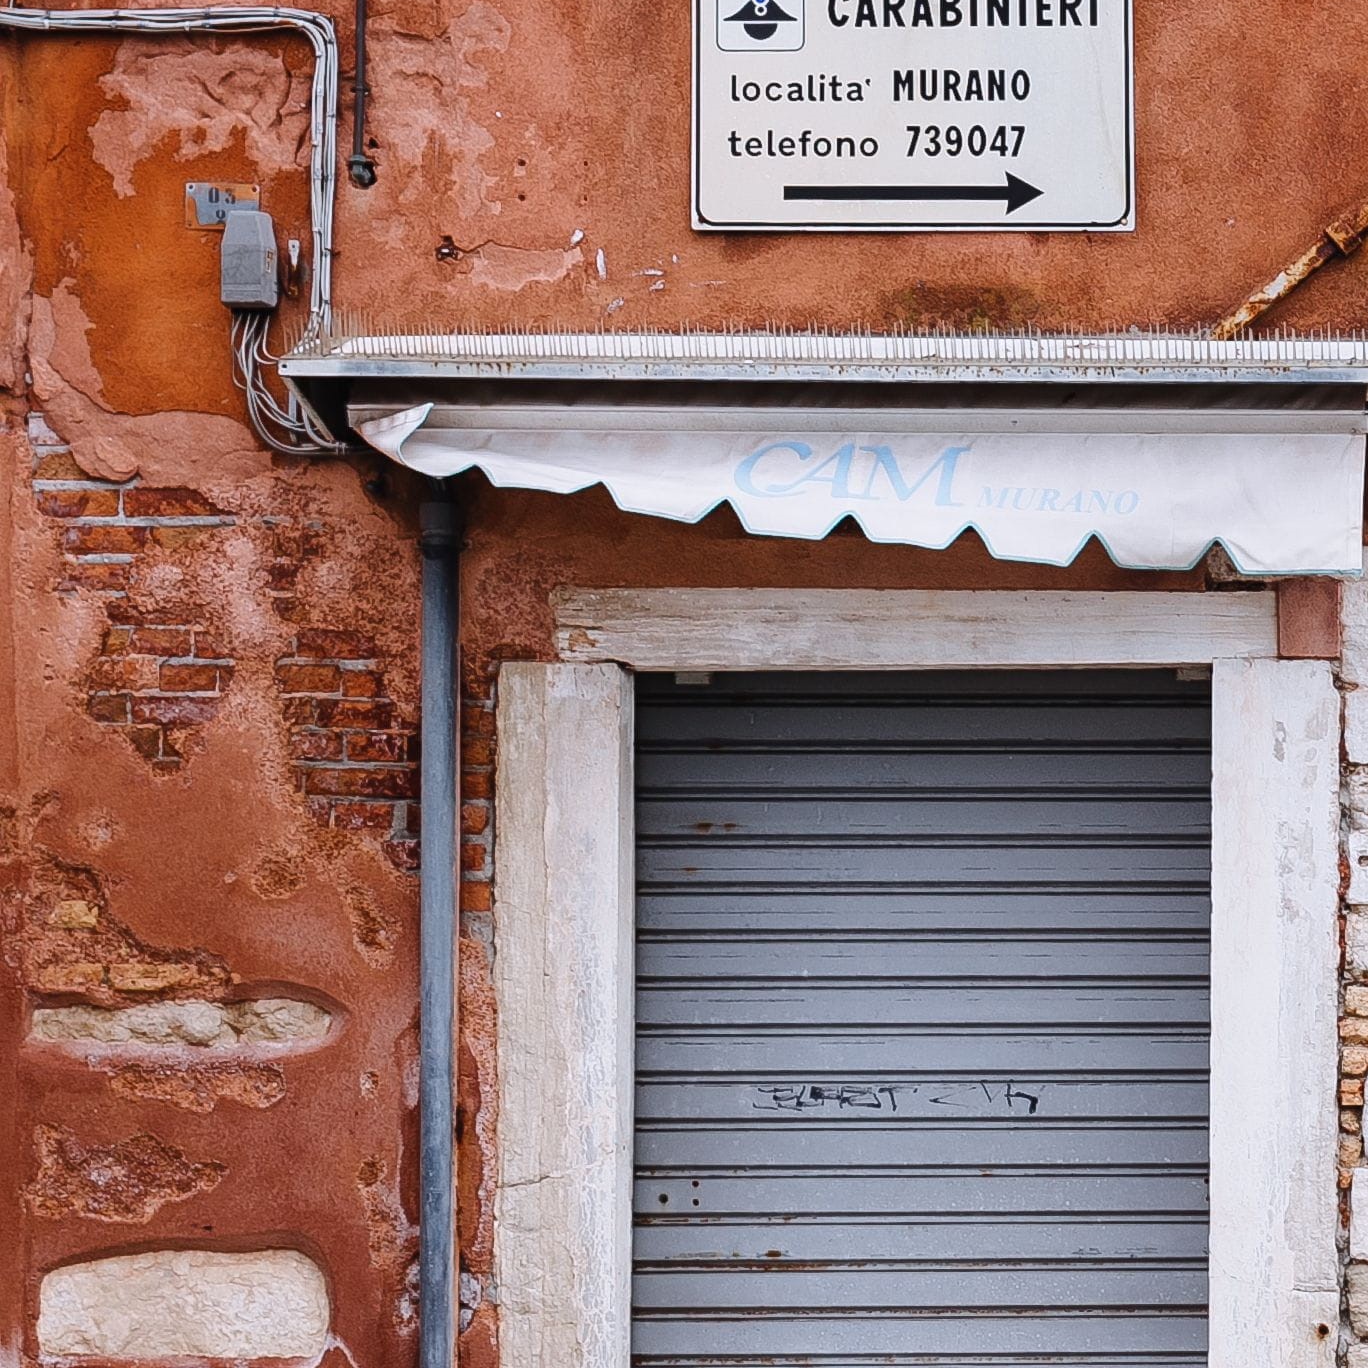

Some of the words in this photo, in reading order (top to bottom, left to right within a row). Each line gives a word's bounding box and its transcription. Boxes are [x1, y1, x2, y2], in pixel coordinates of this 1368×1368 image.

[892, 69, 1031, 102] MURANO
[727, 129, 879, 158] telefono
[905, 125, 1027, 158] 739047
[733, 441, 975, 507] CAM
[977, 486, 1141, 515] MURANO
